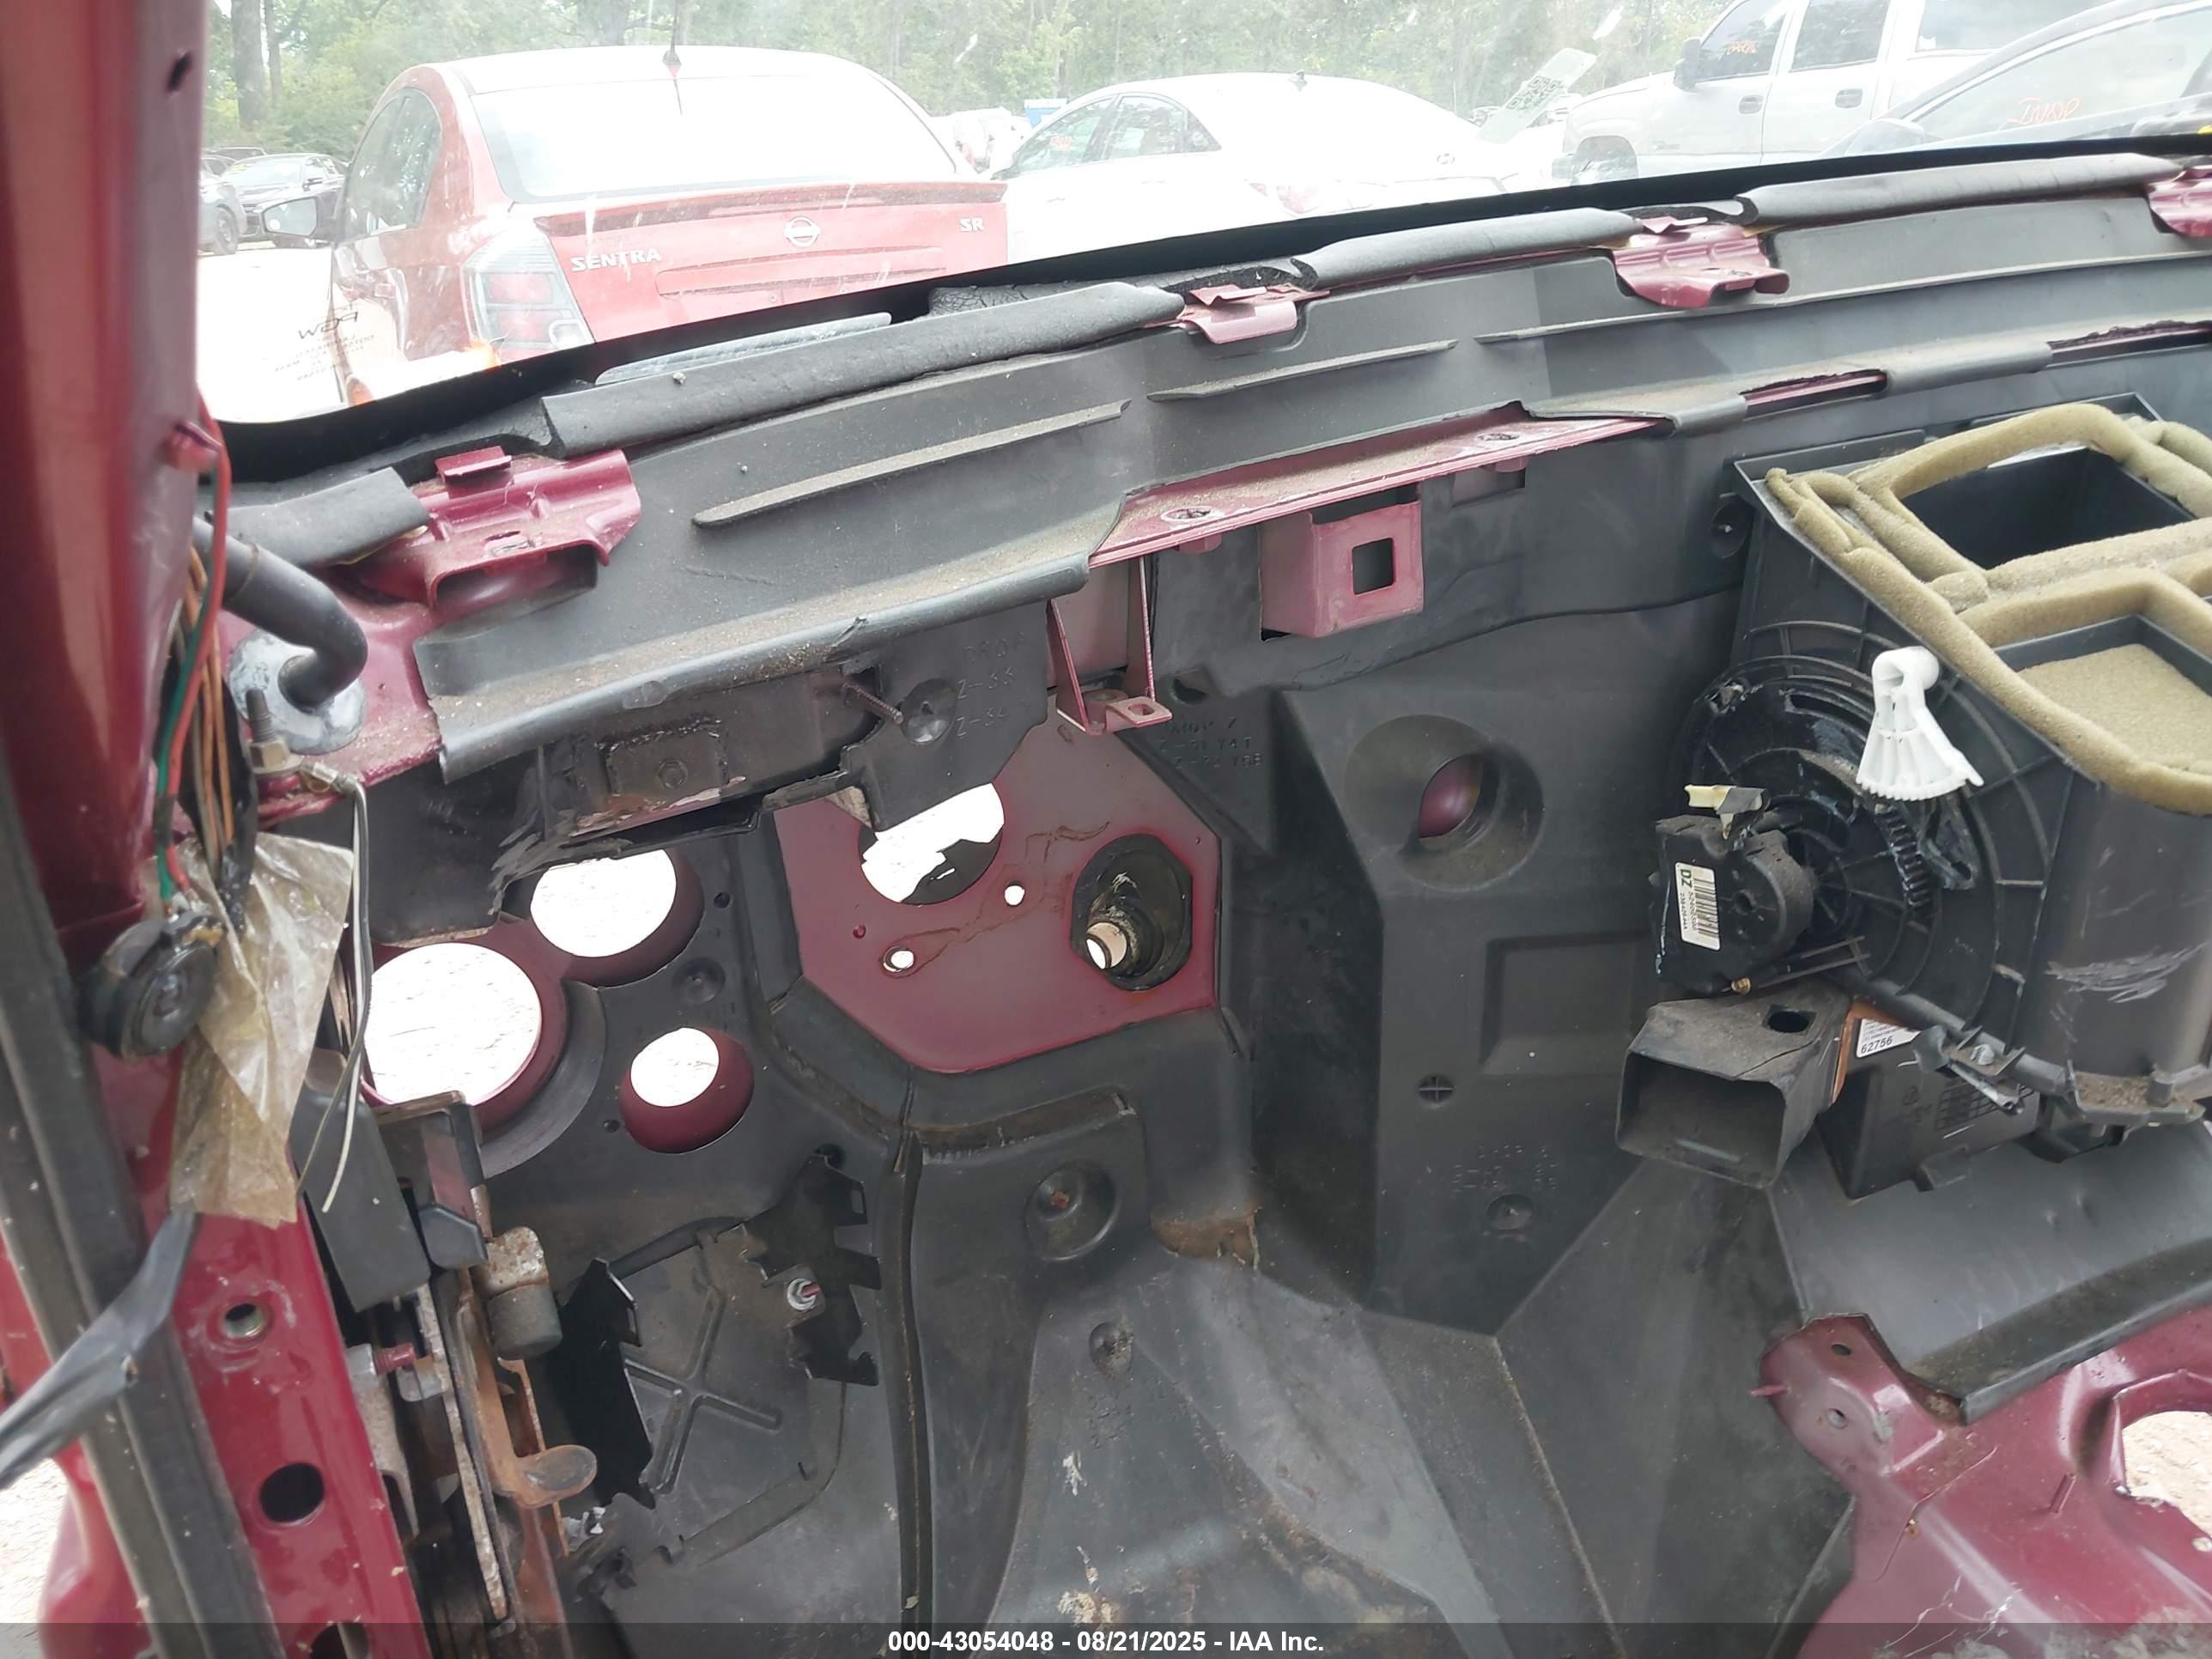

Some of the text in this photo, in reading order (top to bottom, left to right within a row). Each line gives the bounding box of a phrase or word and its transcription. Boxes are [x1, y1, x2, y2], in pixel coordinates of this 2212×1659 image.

[960, 217, 985, 232] SR
[570, 248, 662, 272] SENTRA
[1680, 868, 1692, 888] DZ
[1861, 1036, 1893, 1054] 62756
